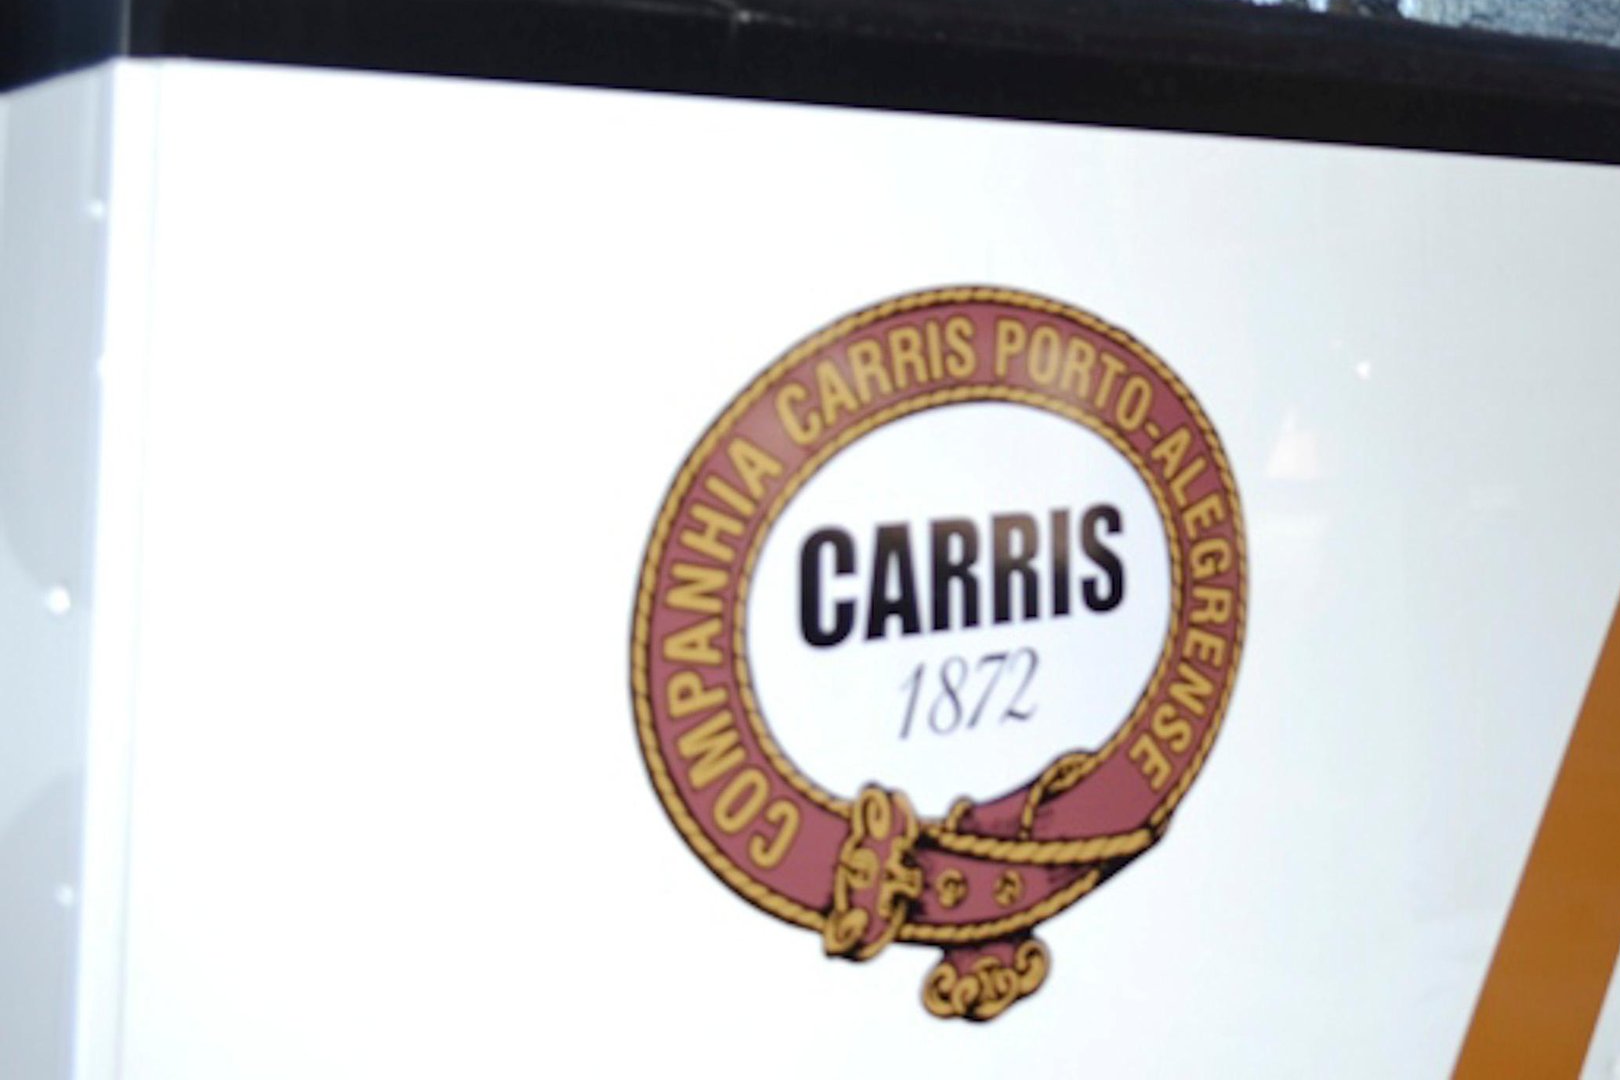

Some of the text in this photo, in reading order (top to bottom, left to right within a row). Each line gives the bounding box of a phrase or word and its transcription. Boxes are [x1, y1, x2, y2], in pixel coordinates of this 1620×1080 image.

[664, 437, 800, 869] COMPANHIA
[775, 317, 975, 444] CARRIS
[798, 503, 1125, 649] CARRIS
[897, 647, 1041, 740] 1872
